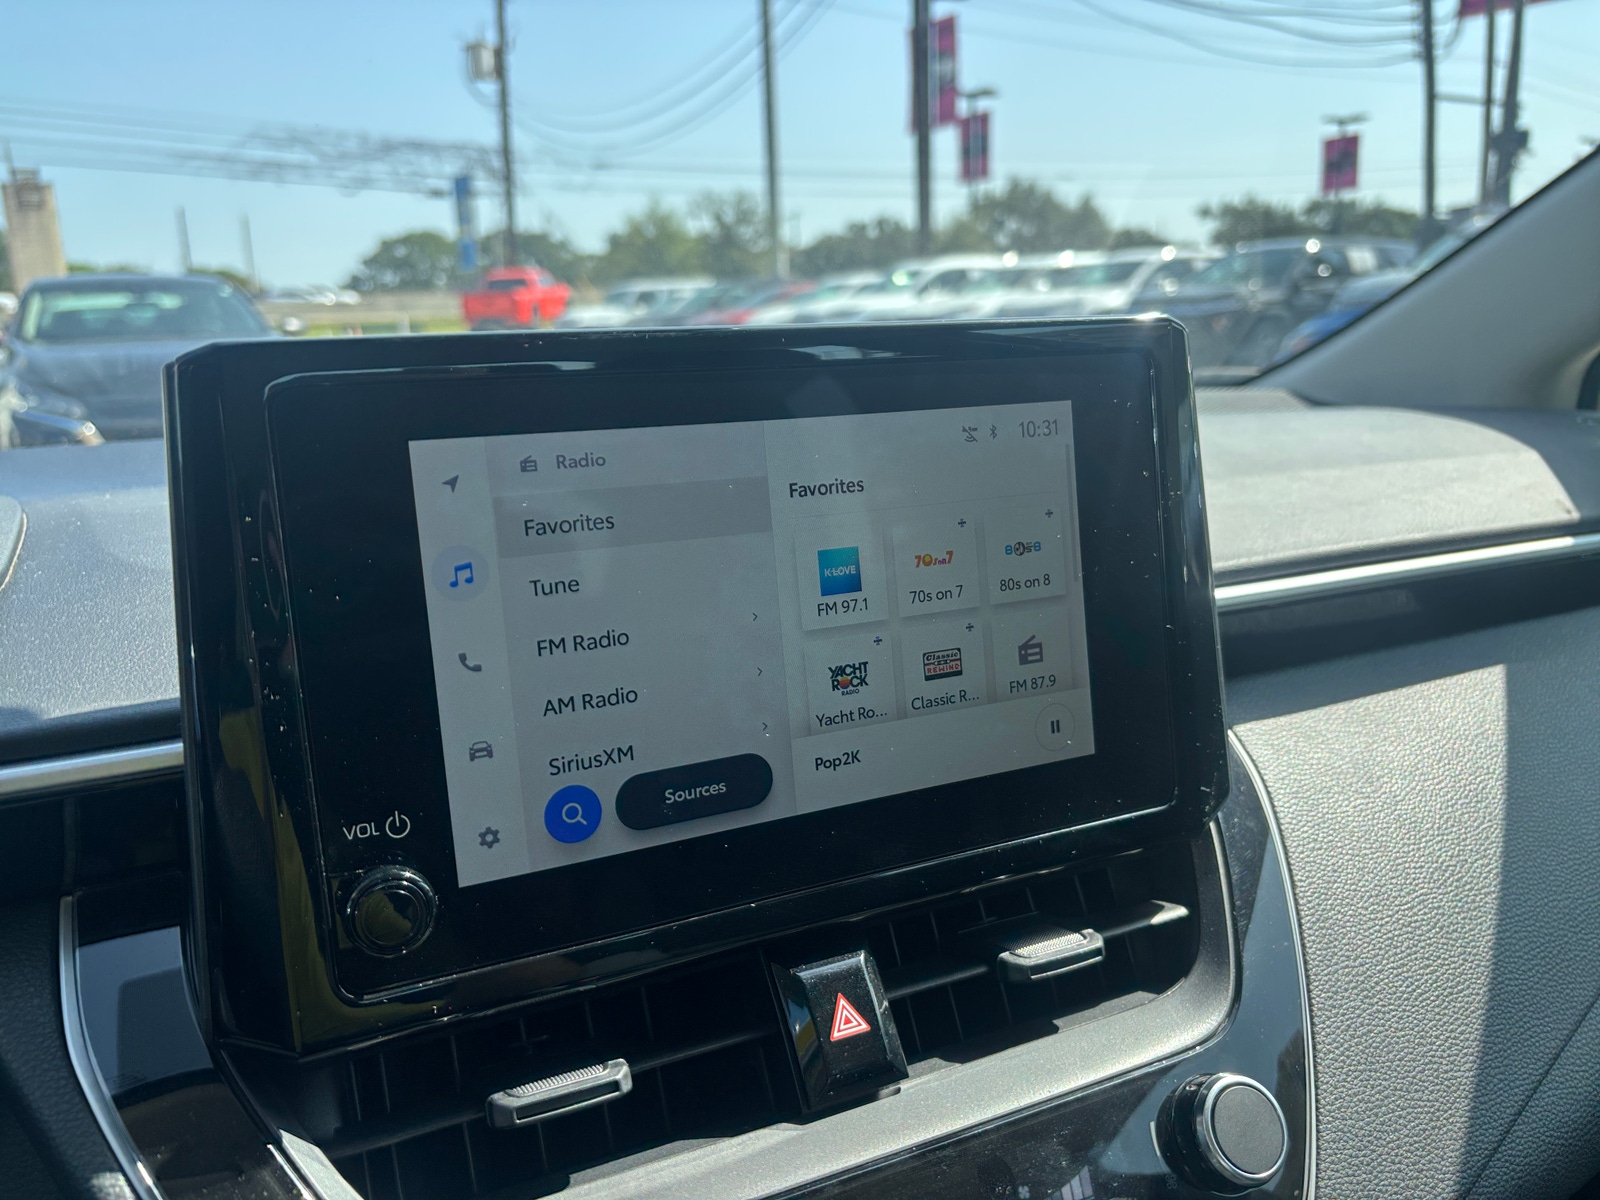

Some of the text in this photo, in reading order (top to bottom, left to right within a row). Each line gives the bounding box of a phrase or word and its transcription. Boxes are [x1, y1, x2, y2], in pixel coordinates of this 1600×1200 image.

[1018, 418, 1058, 438] 10:31
[555, 451, 607, 470] Radio
[789, 477, 865, 499] Favorites
[523, 513, 615, 537] Favorites
[529, 576, 580, 597] Tune
[999, 573, 1051, 592] 80s on 8
[909, 584, 964, 604] 70s on 7
[817, 597, 868, 617] FM 97.1
[536, 629, 630, 657] FM Radio
[925, 650, 959, 662] Classic
[828, 661, 869, 679] YACHT
[926, 663, 960, 675] REWIND
[841, 688, 860, 697] RADIO
[1009, 674, 1057, 694] FM 87.9
[543, 687, 639, 717] AM Radio
[911, 690, 957, 711] Classic
[815, 708, 856, 728] Yacht
[548, 744, 635, 777] SiriusXM
[814, 750, 862, 772] Pop2K
[664, 779, 727, 804] Sources
[343, 821, 380, 840] VOL
